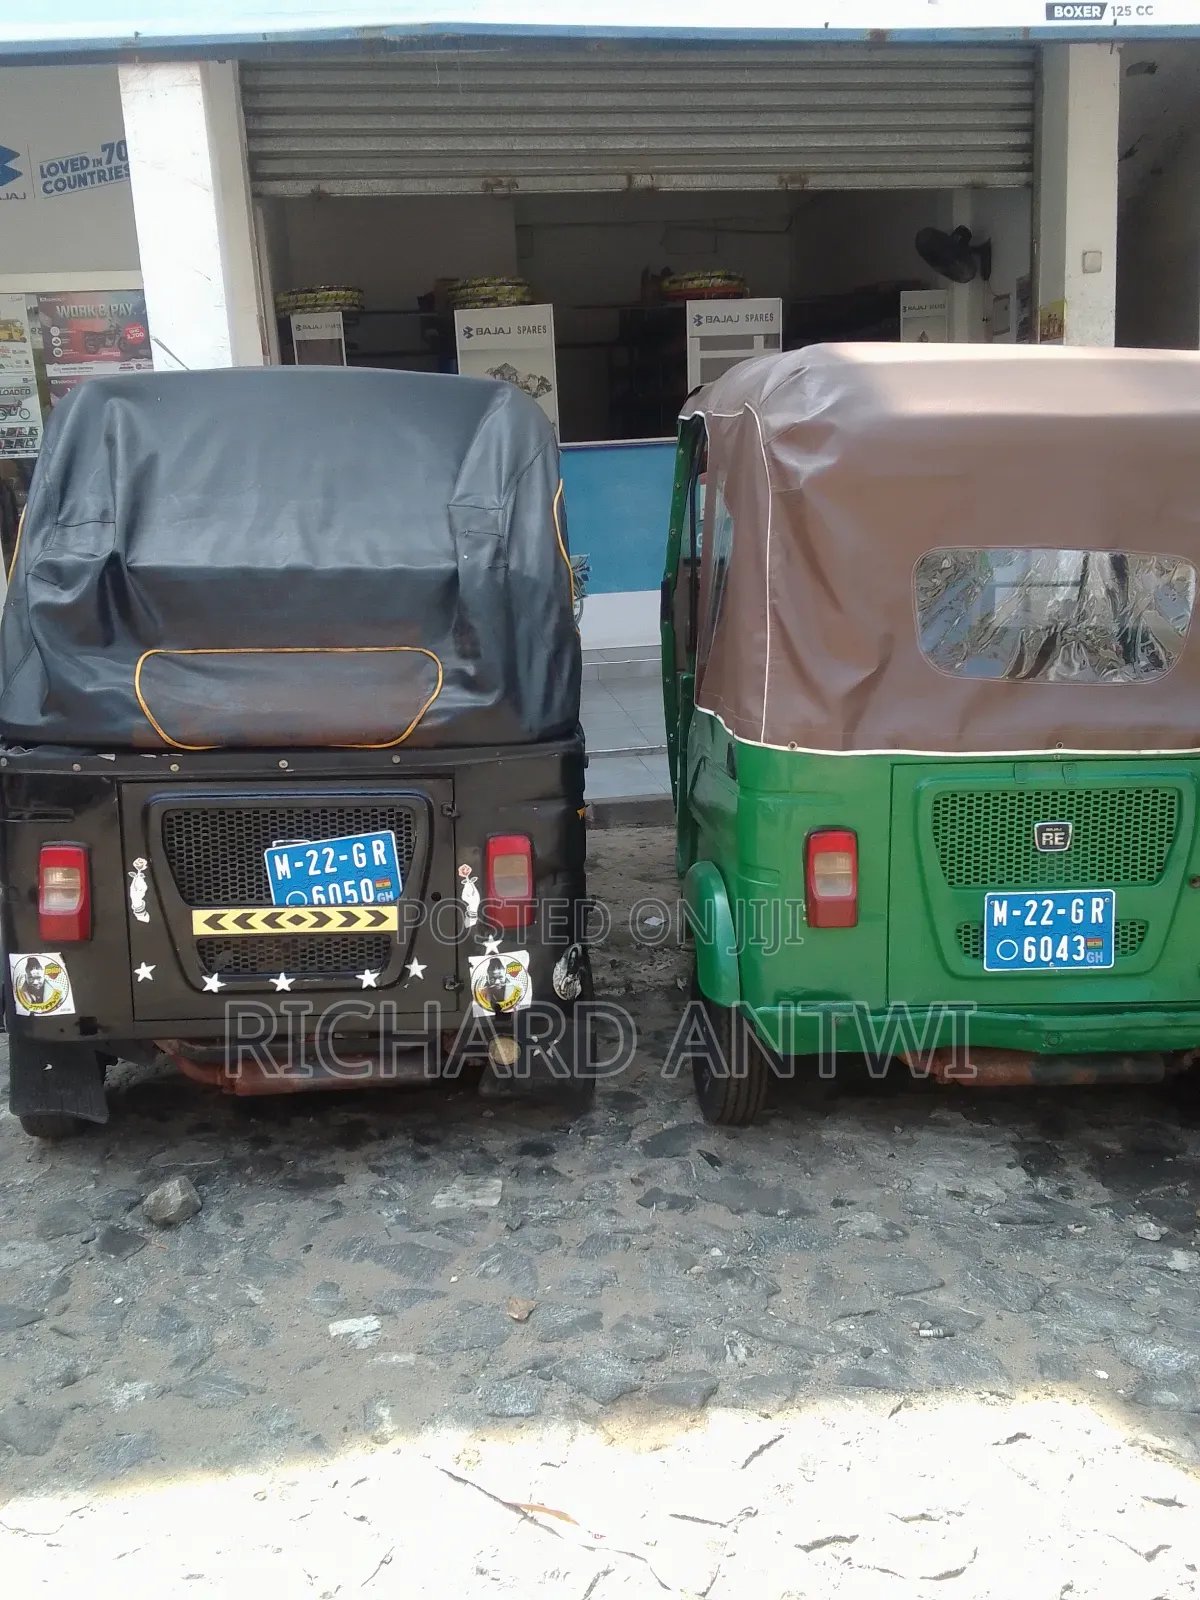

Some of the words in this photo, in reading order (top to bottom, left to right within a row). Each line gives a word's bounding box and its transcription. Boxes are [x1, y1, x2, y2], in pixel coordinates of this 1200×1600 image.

[1054, 6, 1101, 17] BOXER
[1111, 6, 1132, 17] 125
[1136, 5, 1154, 16] CC
[40, 155, 90, 179] LOVED
[92, 157, 103, 168] IN
[101, 140, 129, 165] 70
[42, 163, 130, 195] COUNTRIES
[56, 305, 95, 318] WORK
[109, 303, 133, 316] PAY
[705, 314, 740, 324] BAJAJ
[745, 313, 774, 323] SPARES
[476, 326, 511, 336] BAJAJ
[517, 325, 547, 335] SPARES
[1041, 832, 1065, 846] RE
[311, 877, 375, 905] 6050
[376, 890, 394, 903] GH
[1023, 934, 1085, 963] 6043
[1086, 951, 1104, 963] GH
